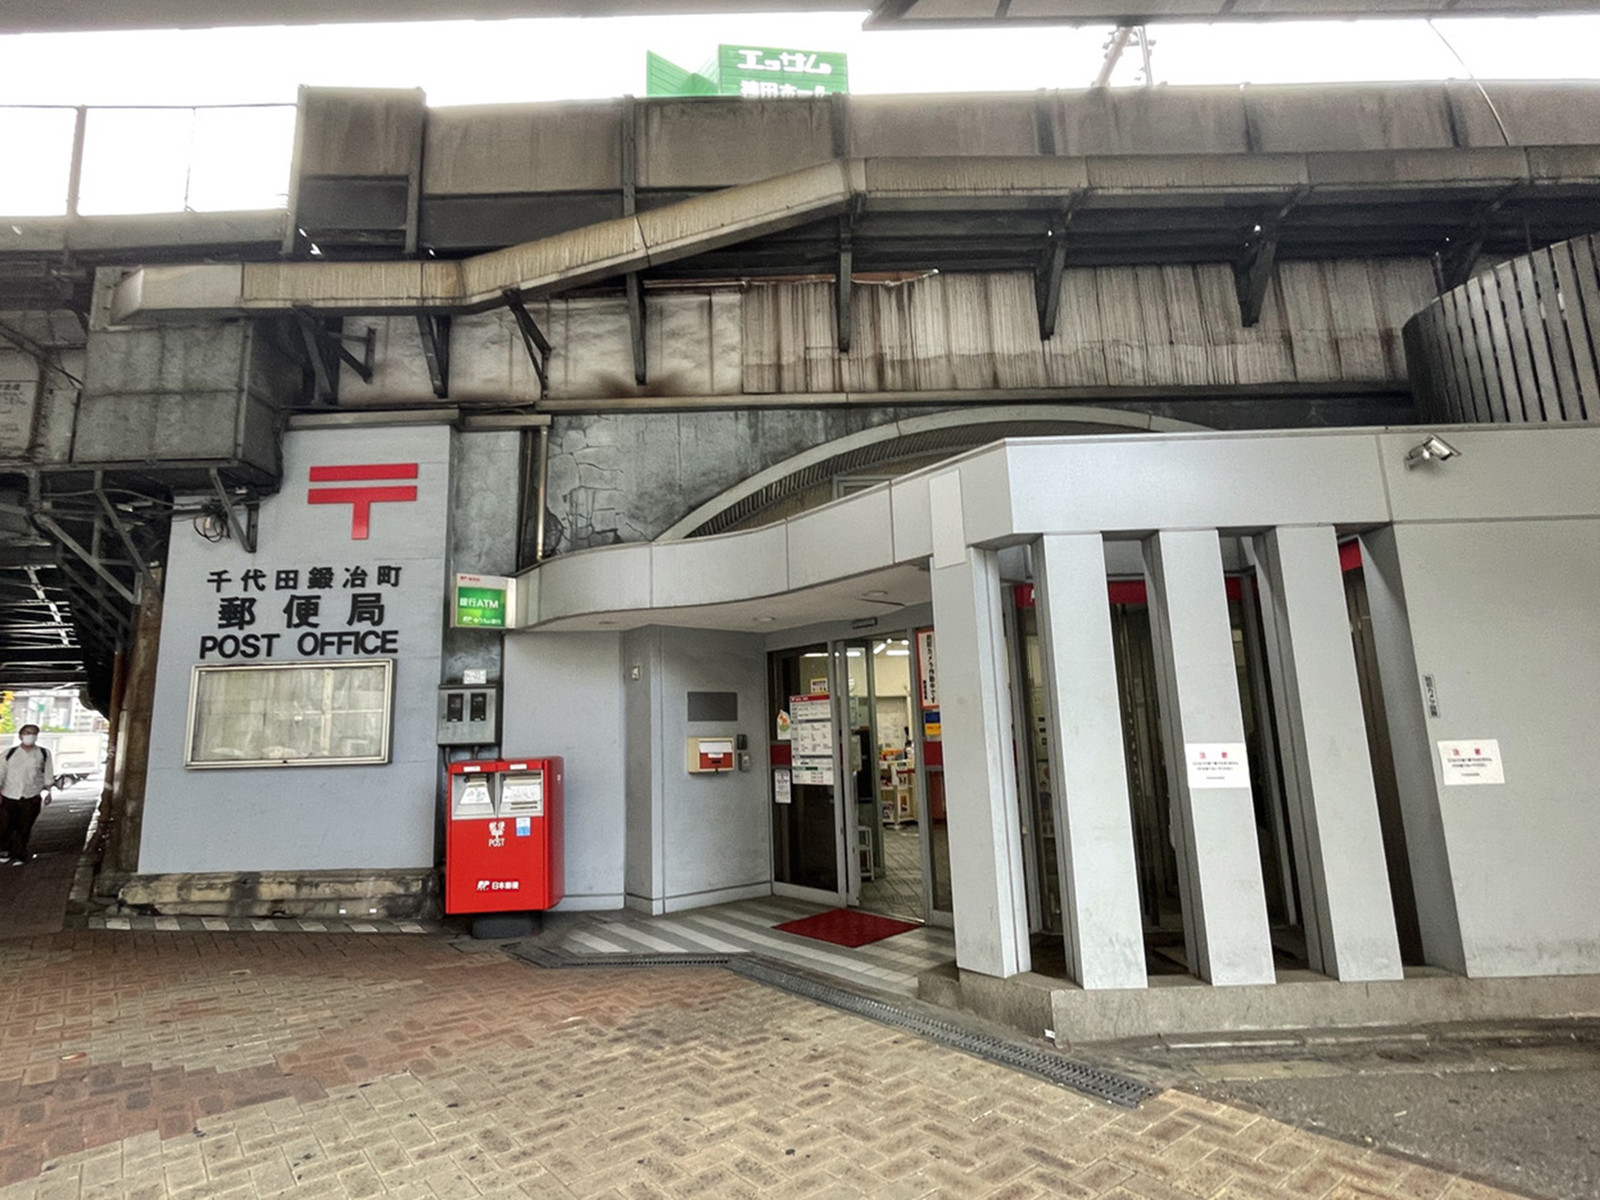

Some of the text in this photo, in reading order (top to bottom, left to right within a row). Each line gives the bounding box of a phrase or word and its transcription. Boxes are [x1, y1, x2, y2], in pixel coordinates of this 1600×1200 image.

[207, 565, 402, 593] 千代田鍛冶町
[218, 593, 385, 630] 郵便局
[199, 630, 399, 660] POST OFFICE
[488, 838, 505, 847] POST
